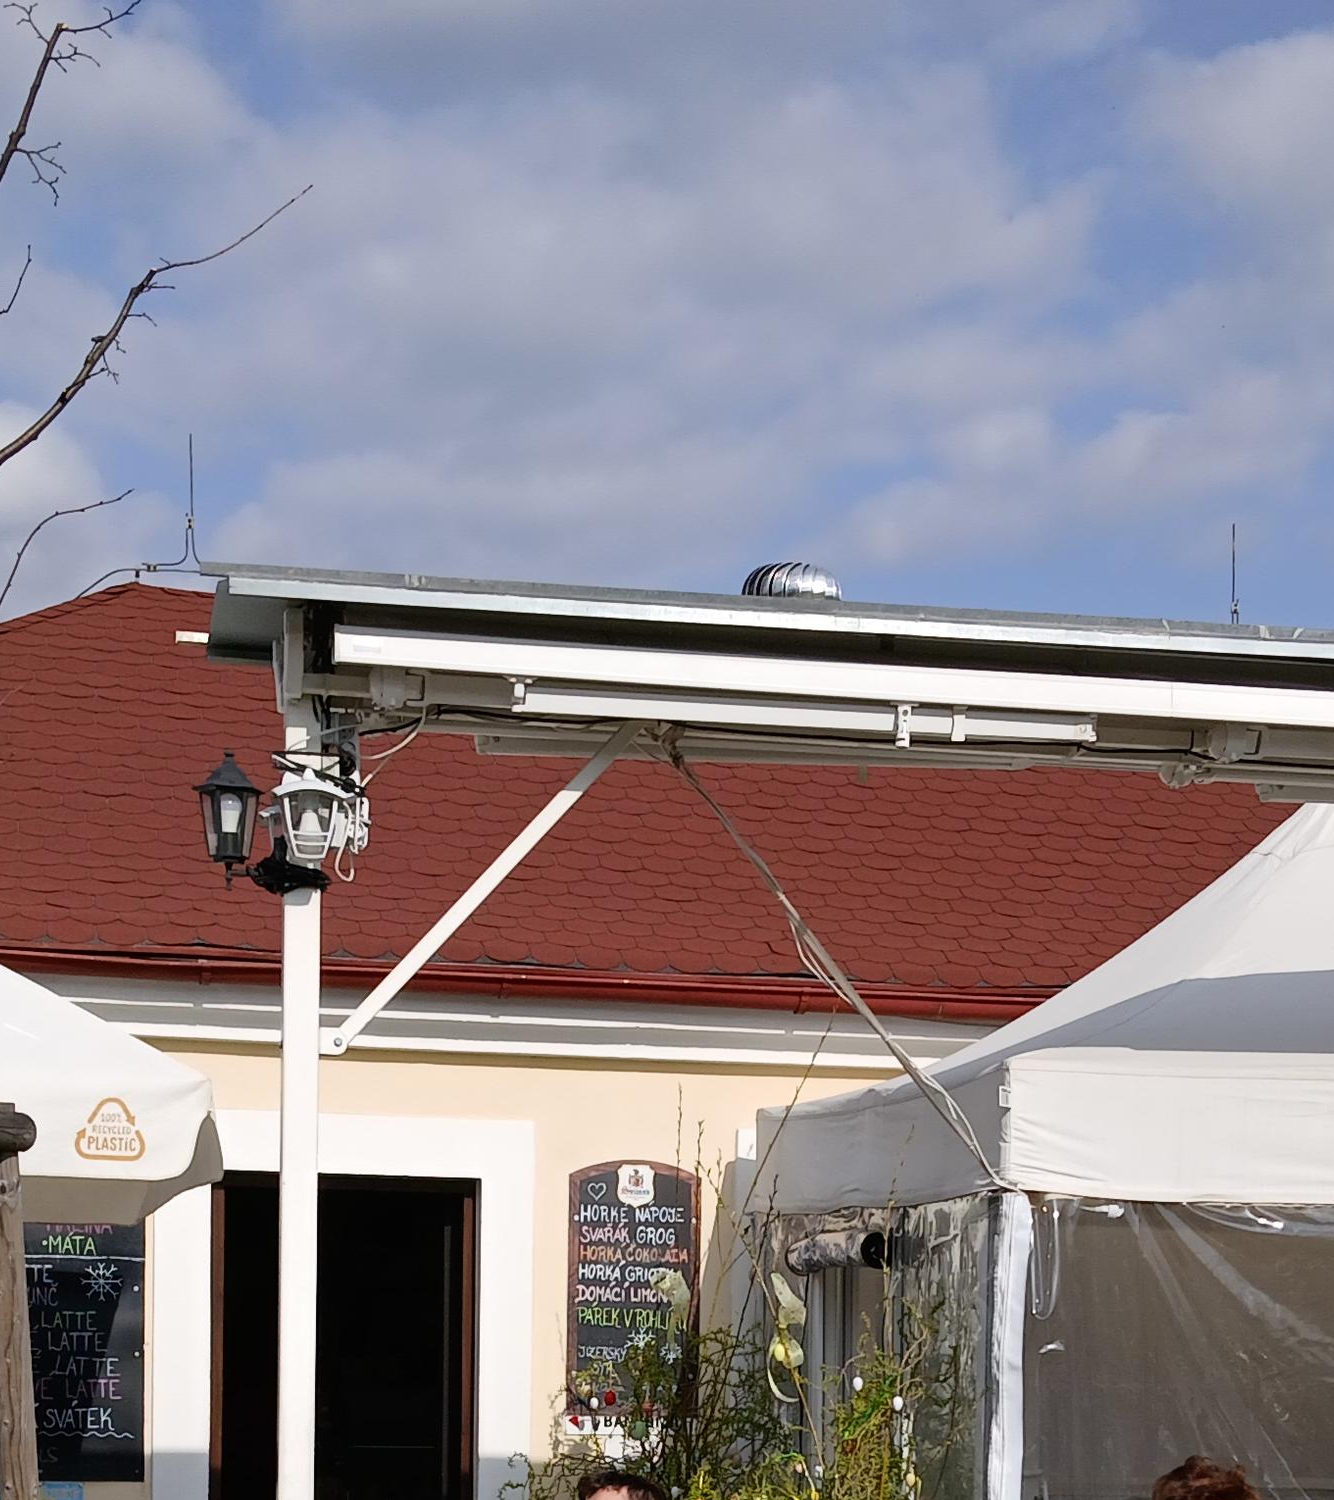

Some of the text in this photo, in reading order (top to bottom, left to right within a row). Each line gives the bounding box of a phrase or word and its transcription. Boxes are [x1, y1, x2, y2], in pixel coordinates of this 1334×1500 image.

[91, 1125, 132, 1135] RECYCLED
[580, 1200, 684, 1223] HORKÉ NÁPOJE
[48, 1231, 97, 1255] MÁTA
[636, 1226, 676, 1246] GROG
[580, 1242, 623, 1262] HORKÁ
[578, 1260, 622, 1282] HORKÁ
[575, 1282, 629, 1303] DOMÁCÍ
[41, 1311, 98, 1331] LATTE
[577, 1301, 621, 1328] PÁREK
[623, 1309, 634, 1328] V
[48, 1331, 108, 1351] LATTE
[50, 1356, 121, 1377] LATTE
[66, 1378, 123, 1400] LATTE
[43, 1399, 116, 1431] SVÁTEK
